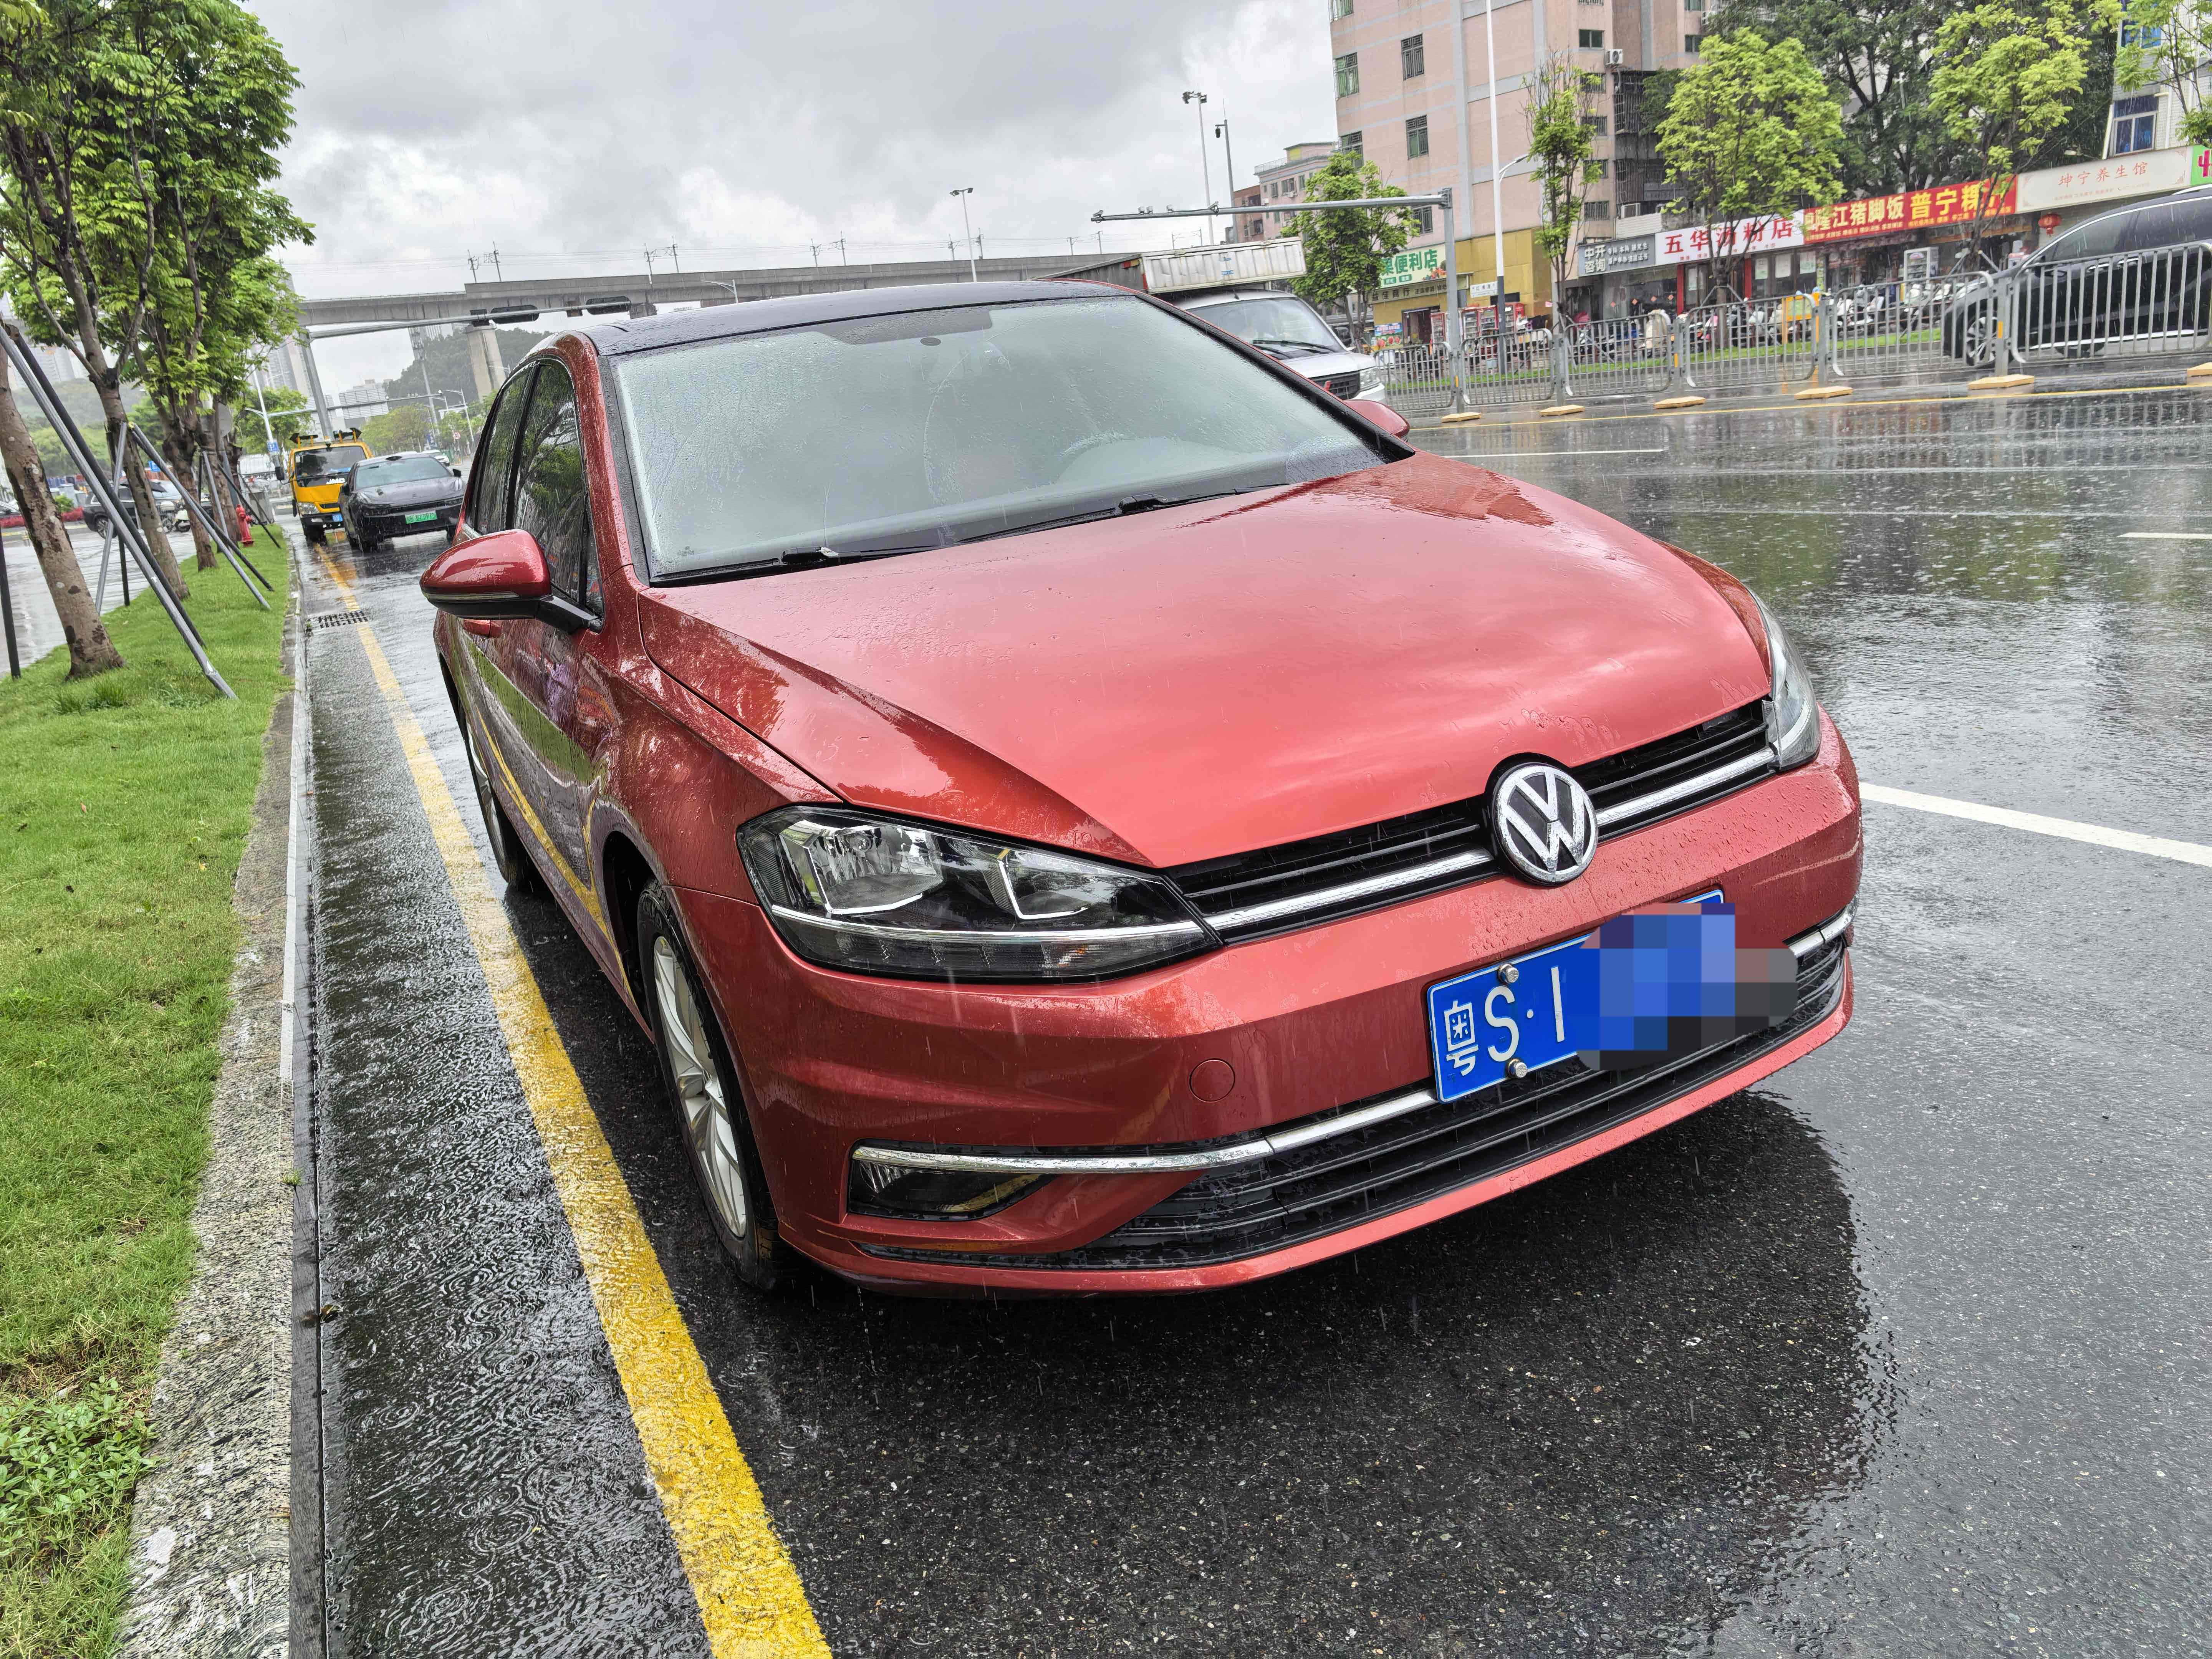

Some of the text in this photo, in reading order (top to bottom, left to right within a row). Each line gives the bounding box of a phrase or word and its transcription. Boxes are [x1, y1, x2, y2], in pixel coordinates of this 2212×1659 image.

[2058, 162, 2147, 187] 坤宁养生馆
[1585, 245, 1606, 260] 中开
[1585, 258, 1606, 273] 咨询
